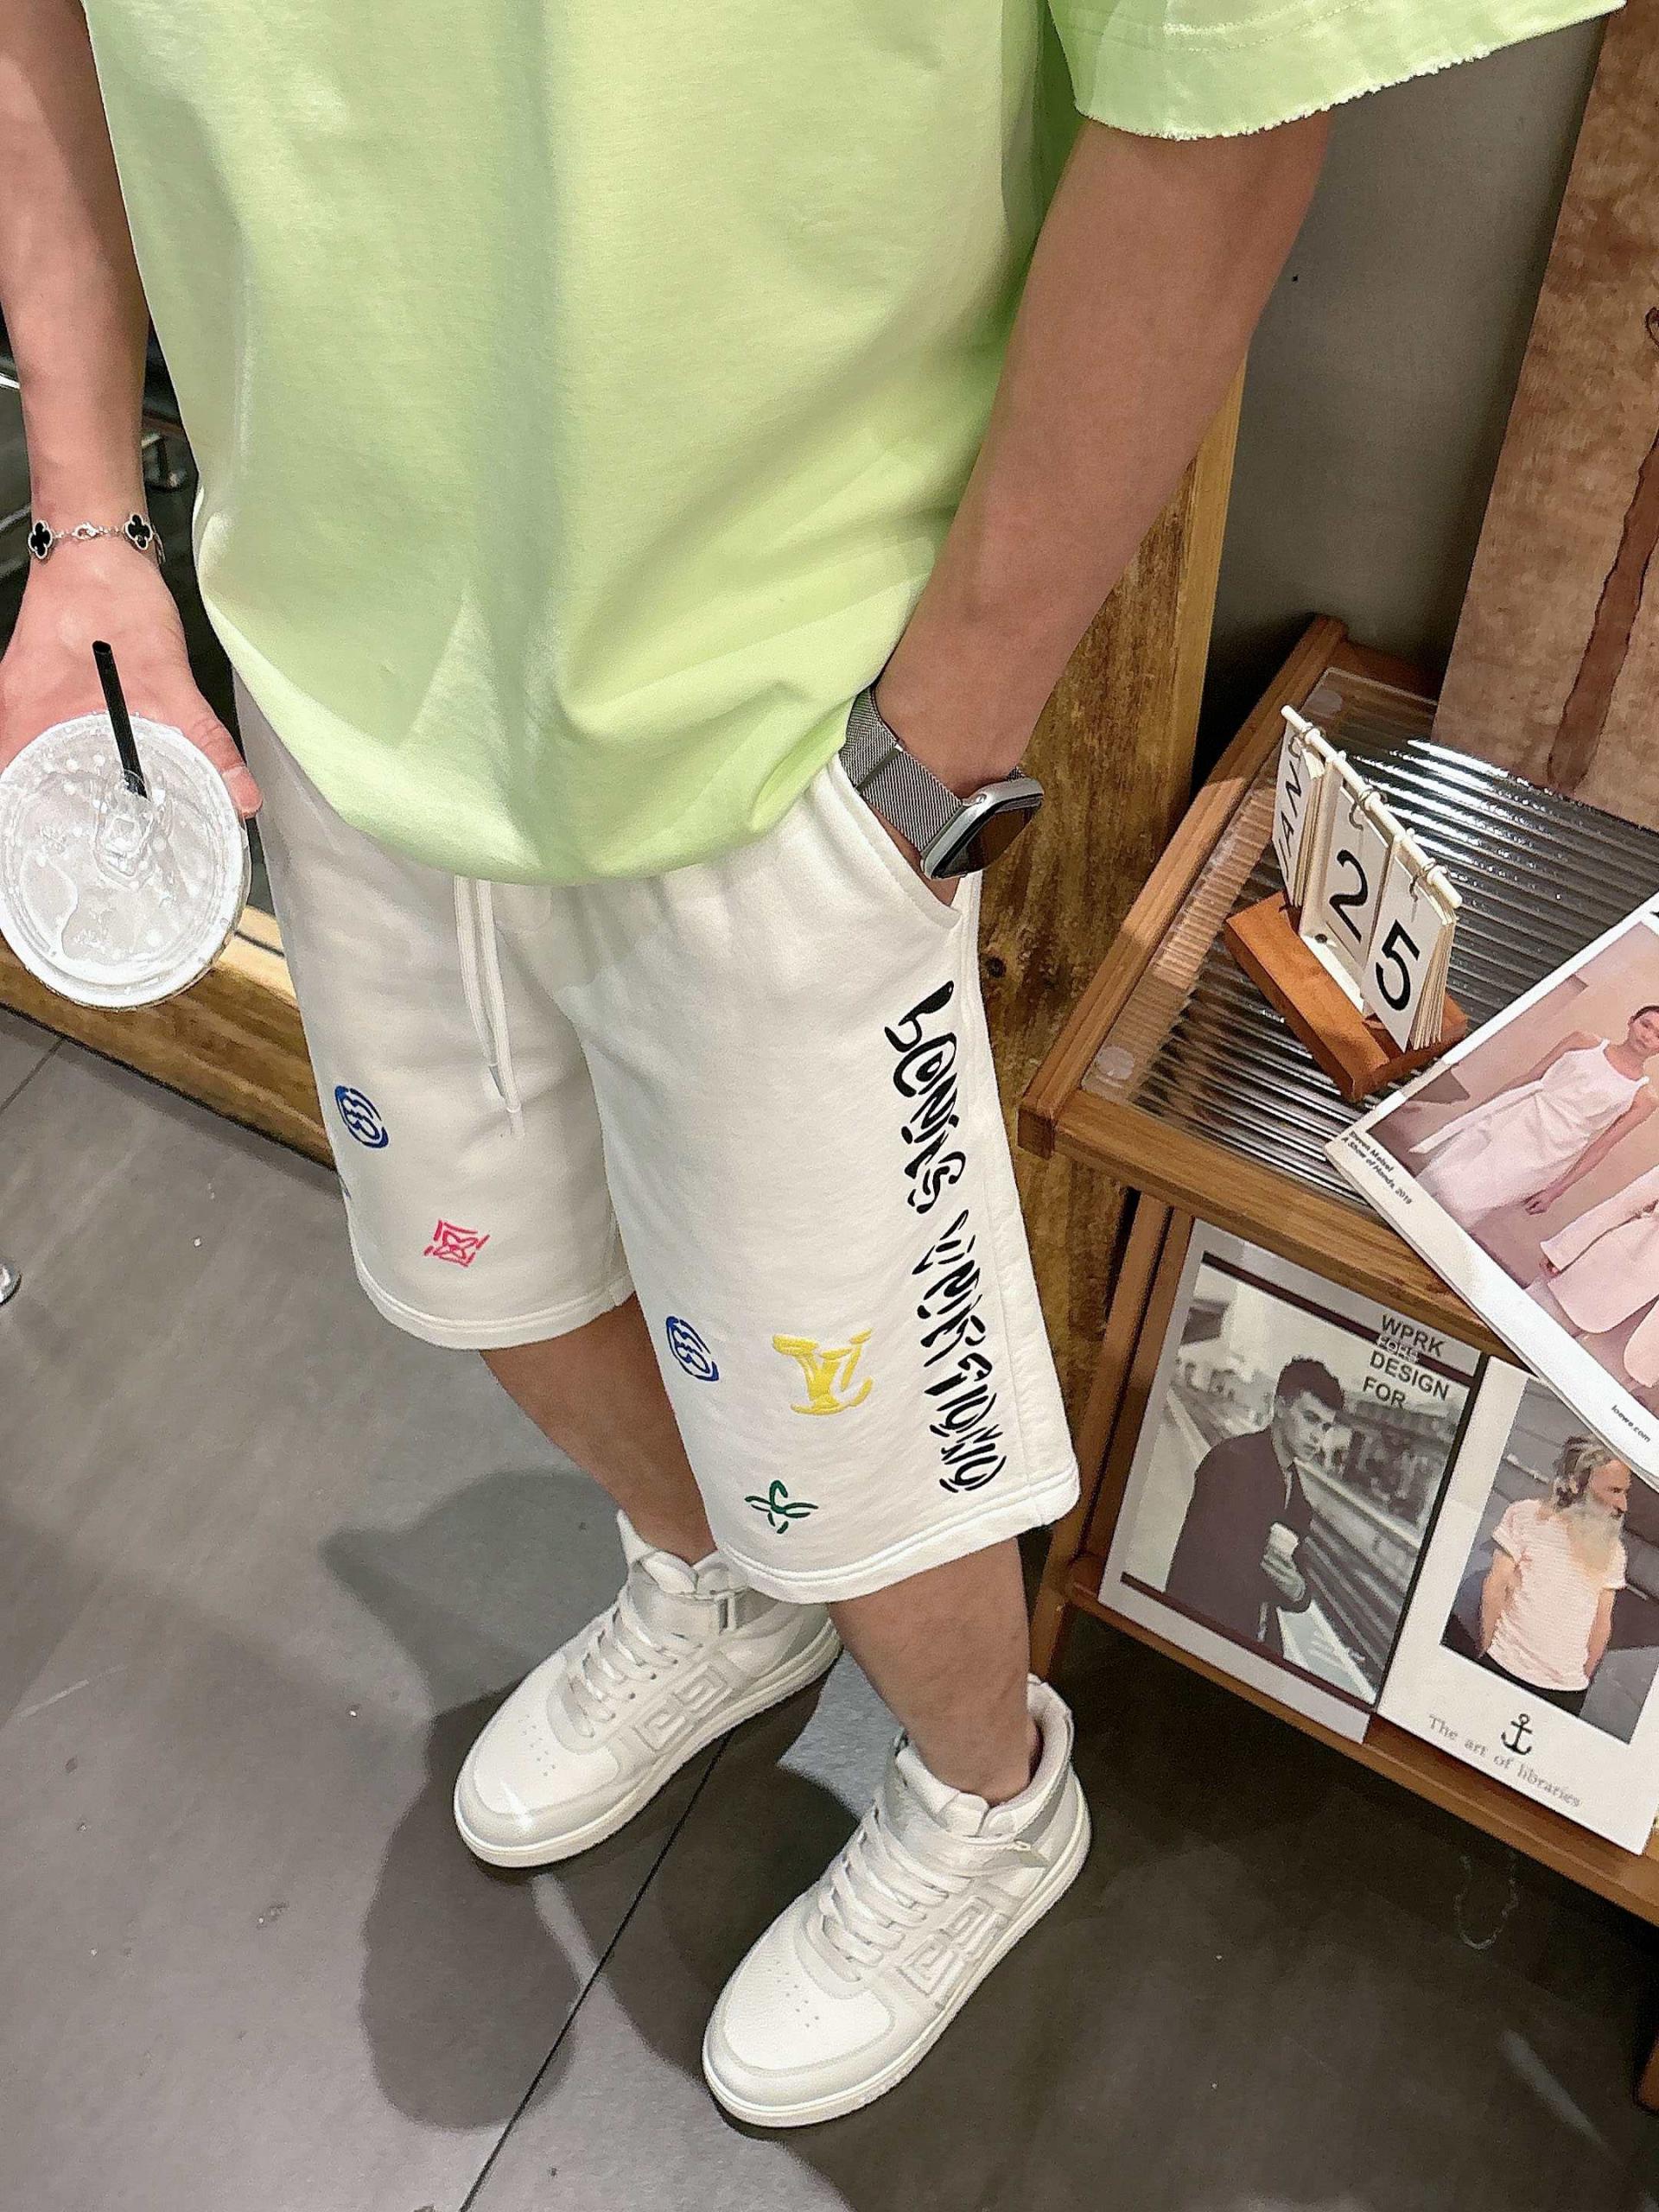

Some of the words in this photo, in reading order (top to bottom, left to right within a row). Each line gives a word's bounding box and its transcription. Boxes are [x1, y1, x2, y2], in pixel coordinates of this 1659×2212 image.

[1382, 1314, 1445, 1357] WPRK
[1363, 1376, 1407, 1409] FOR
[1370, 1351, 1450, 1402] DESIGN
[1611, 1405, 1651, 1443] loewe.com
[1428, 1713, 1459, 1740] The
[1464, 1738, 1488, 1757] art
[1493, 1756, 1515, 1770] of
[1517, 1764, 1581, 1808] libraries
